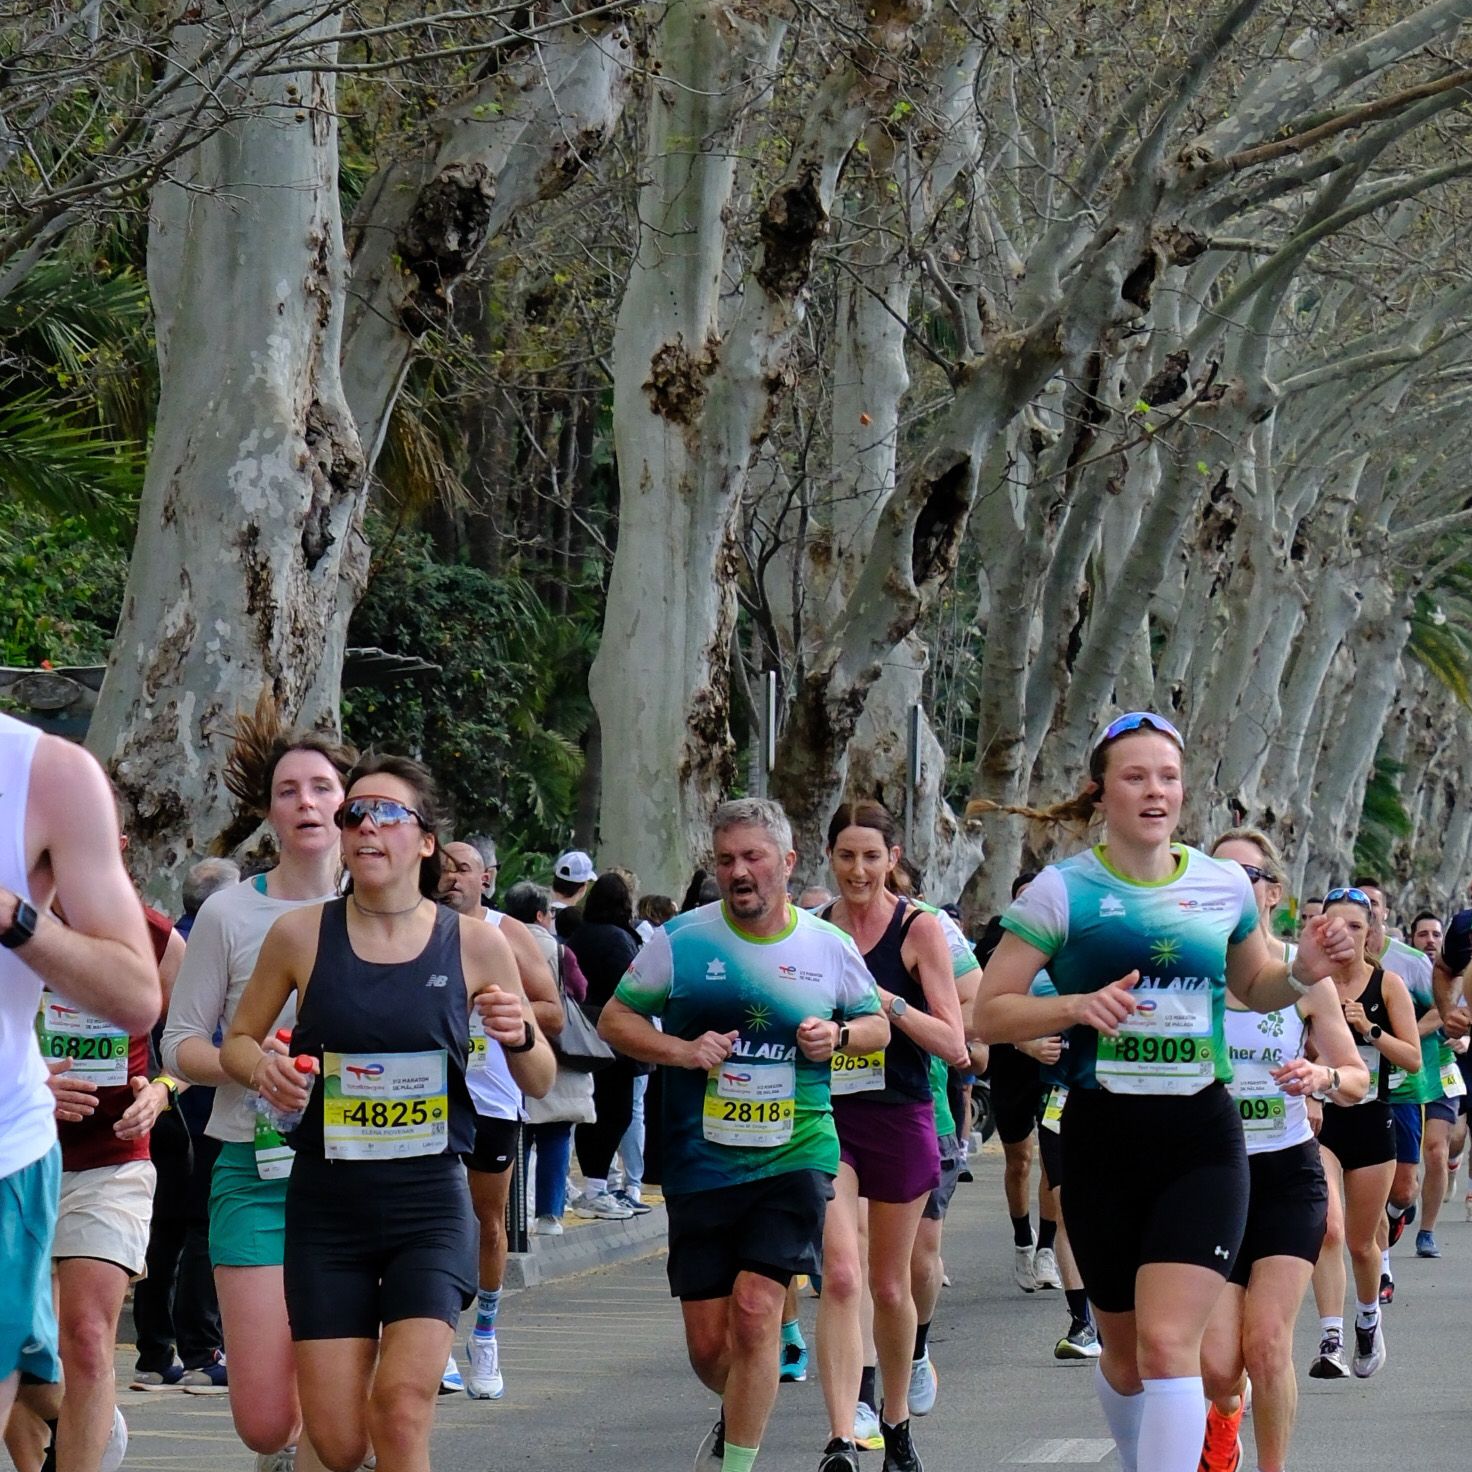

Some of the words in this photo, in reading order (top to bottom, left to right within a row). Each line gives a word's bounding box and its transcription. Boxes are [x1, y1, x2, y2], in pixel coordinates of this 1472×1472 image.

[51, 1036, 113, 1060] 6820
[732, 1038, 797, 1061] ÁLAGA
[1262, 1047, 1283, 1062] AC
[343, 1100, 428, 1128] F4825
[722, 1101, 780, 1123] 2818
